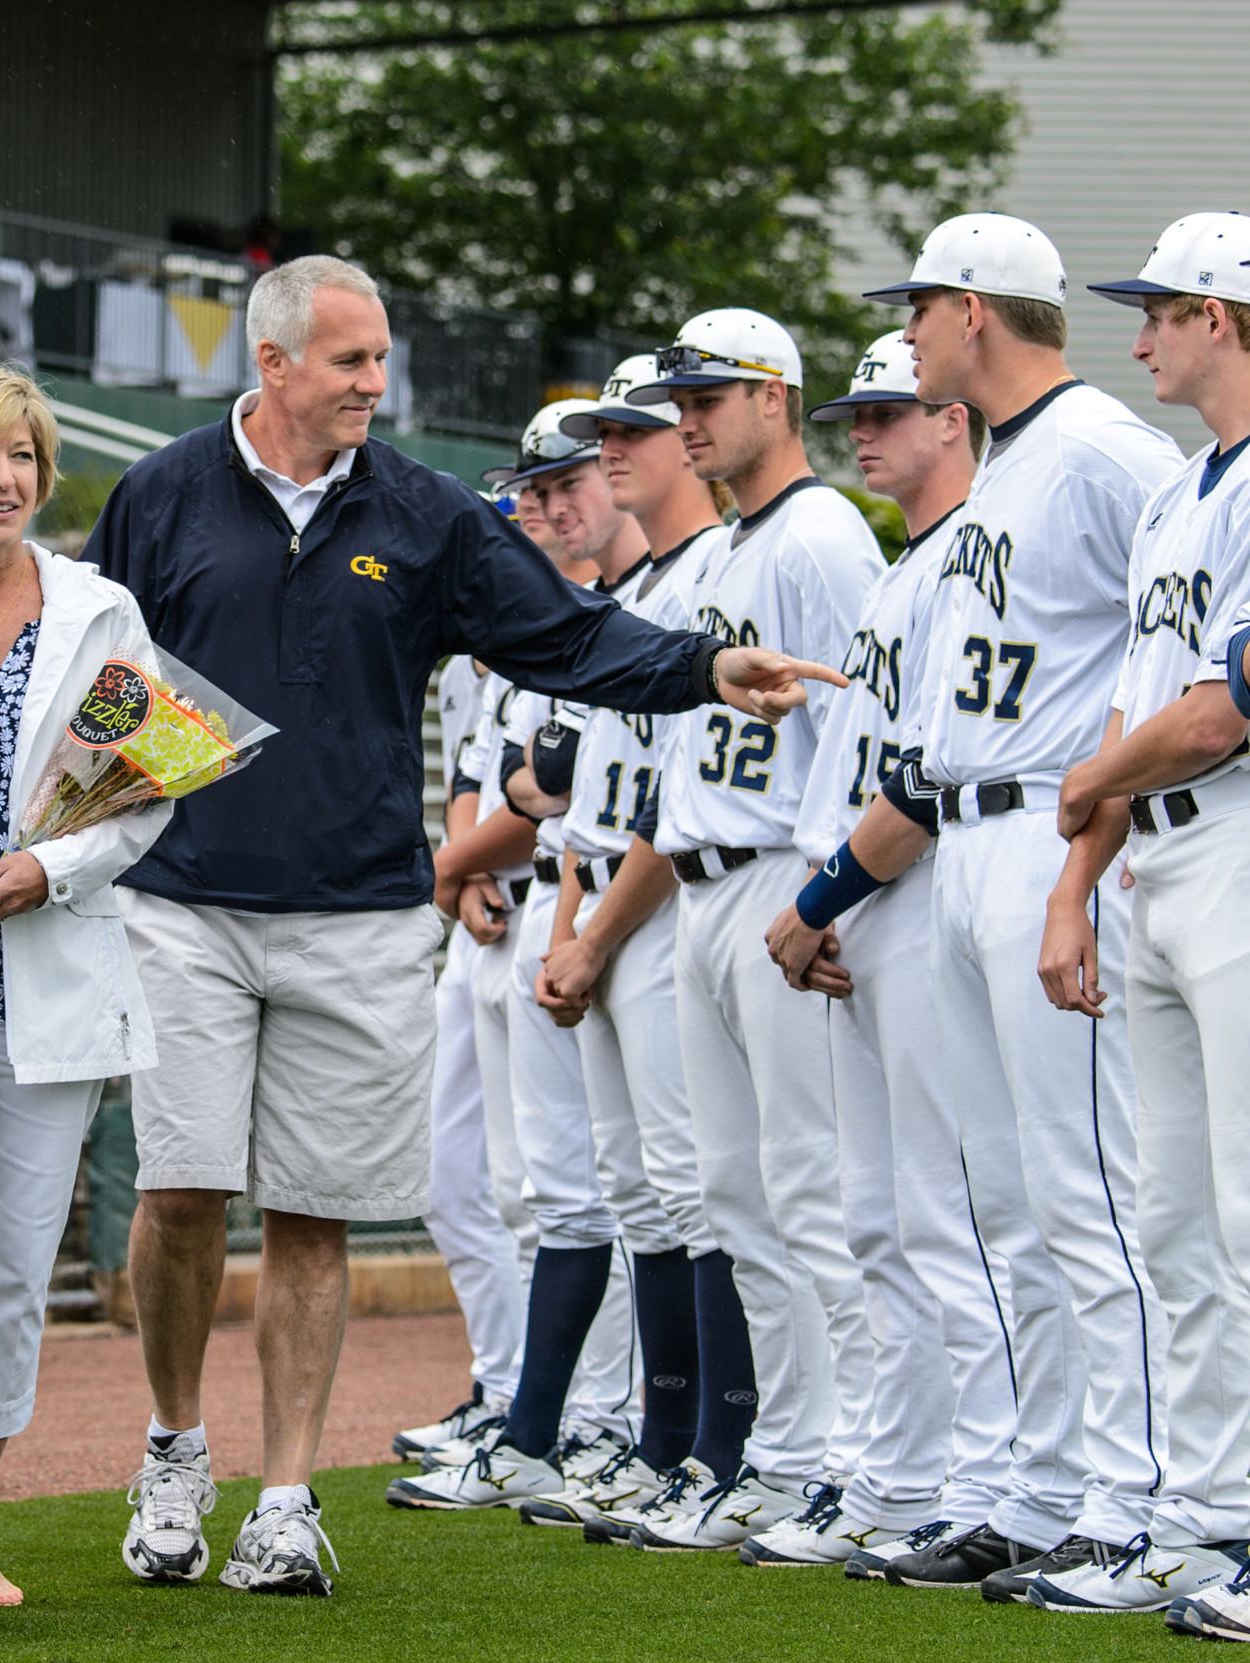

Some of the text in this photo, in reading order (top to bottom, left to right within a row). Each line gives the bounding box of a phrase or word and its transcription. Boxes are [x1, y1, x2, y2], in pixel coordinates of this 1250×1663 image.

[350, 555, 388, 582] GT
[954, 634, 1038, 722] 37
[71, 711, 119, 741] OUQUET
[81, 691, 139, 733] izzler
[698, 711, 779, 795] 32
[596, 760, 654, 833] 11
